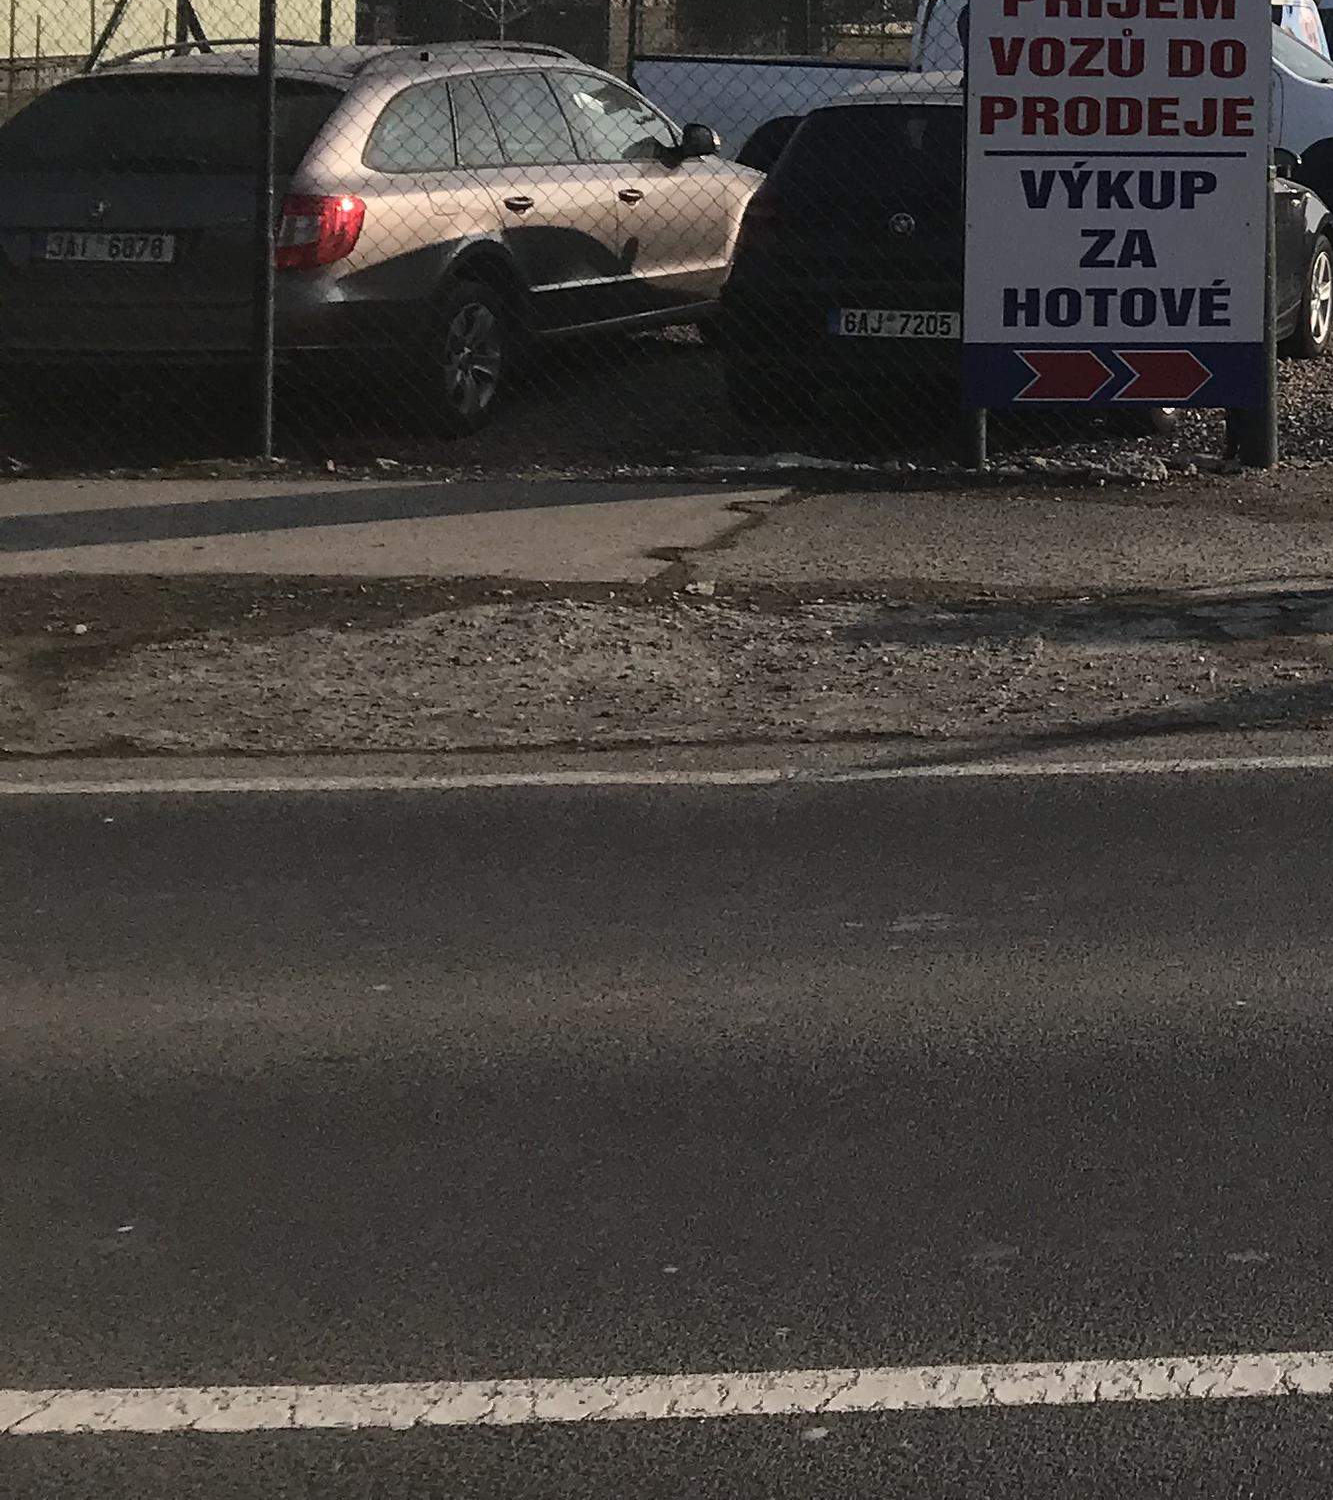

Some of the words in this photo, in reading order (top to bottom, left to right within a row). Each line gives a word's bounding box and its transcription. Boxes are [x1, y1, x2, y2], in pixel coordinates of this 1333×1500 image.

[988, 28, 1145, 78] VOZŮ
[1167, 38, 1247, 79] DO
[979, 95, 1255, 138] PRODEJE
[1019, 161, 1218, 210] VÝKUP
[1079, 228, 1158, 269] ZA
[844, 311, 882, 334] 6AJ
[899, 313, 951, 337] 7205
[1002, 279, 1232, 328] HOTOVÉ
